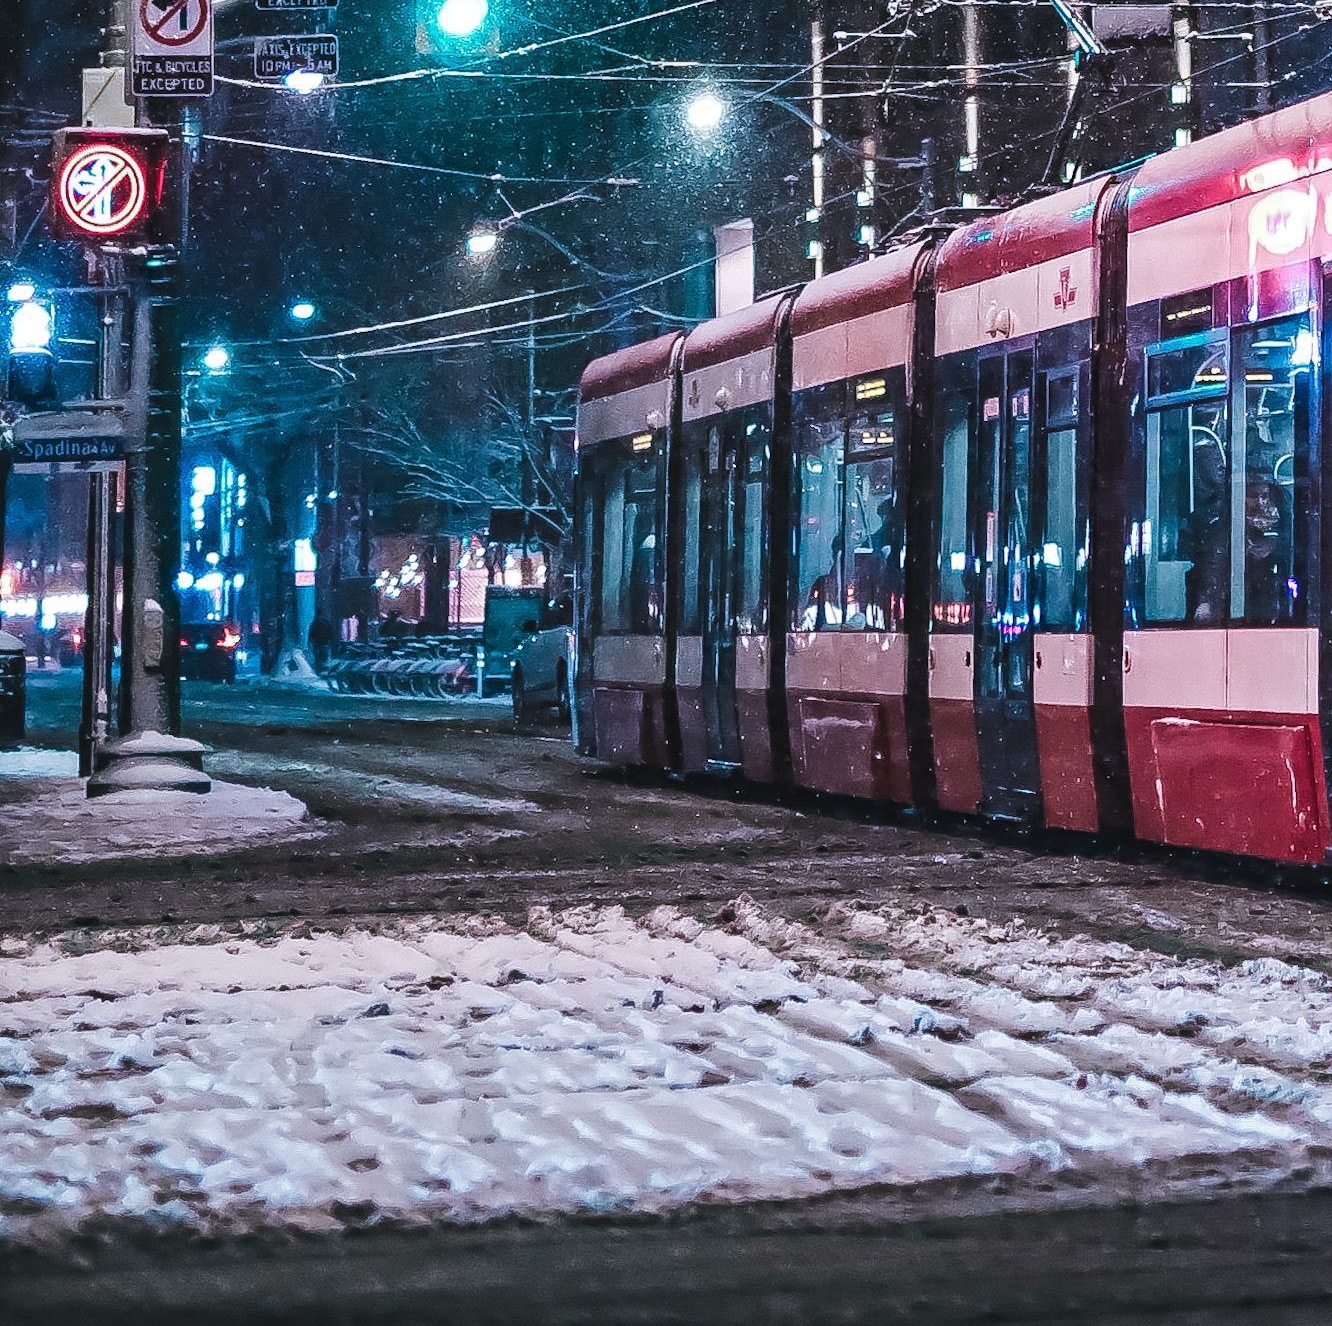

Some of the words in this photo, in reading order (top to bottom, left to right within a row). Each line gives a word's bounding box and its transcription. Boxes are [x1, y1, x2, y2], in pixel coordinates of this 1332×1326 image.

[258, 43, 284, 56] AXIS
[165, 61, 210, 73] BICYCLES
[141, 78, 205, 90] EXCEPTED
[24, 440, 91, 460] Spadina
